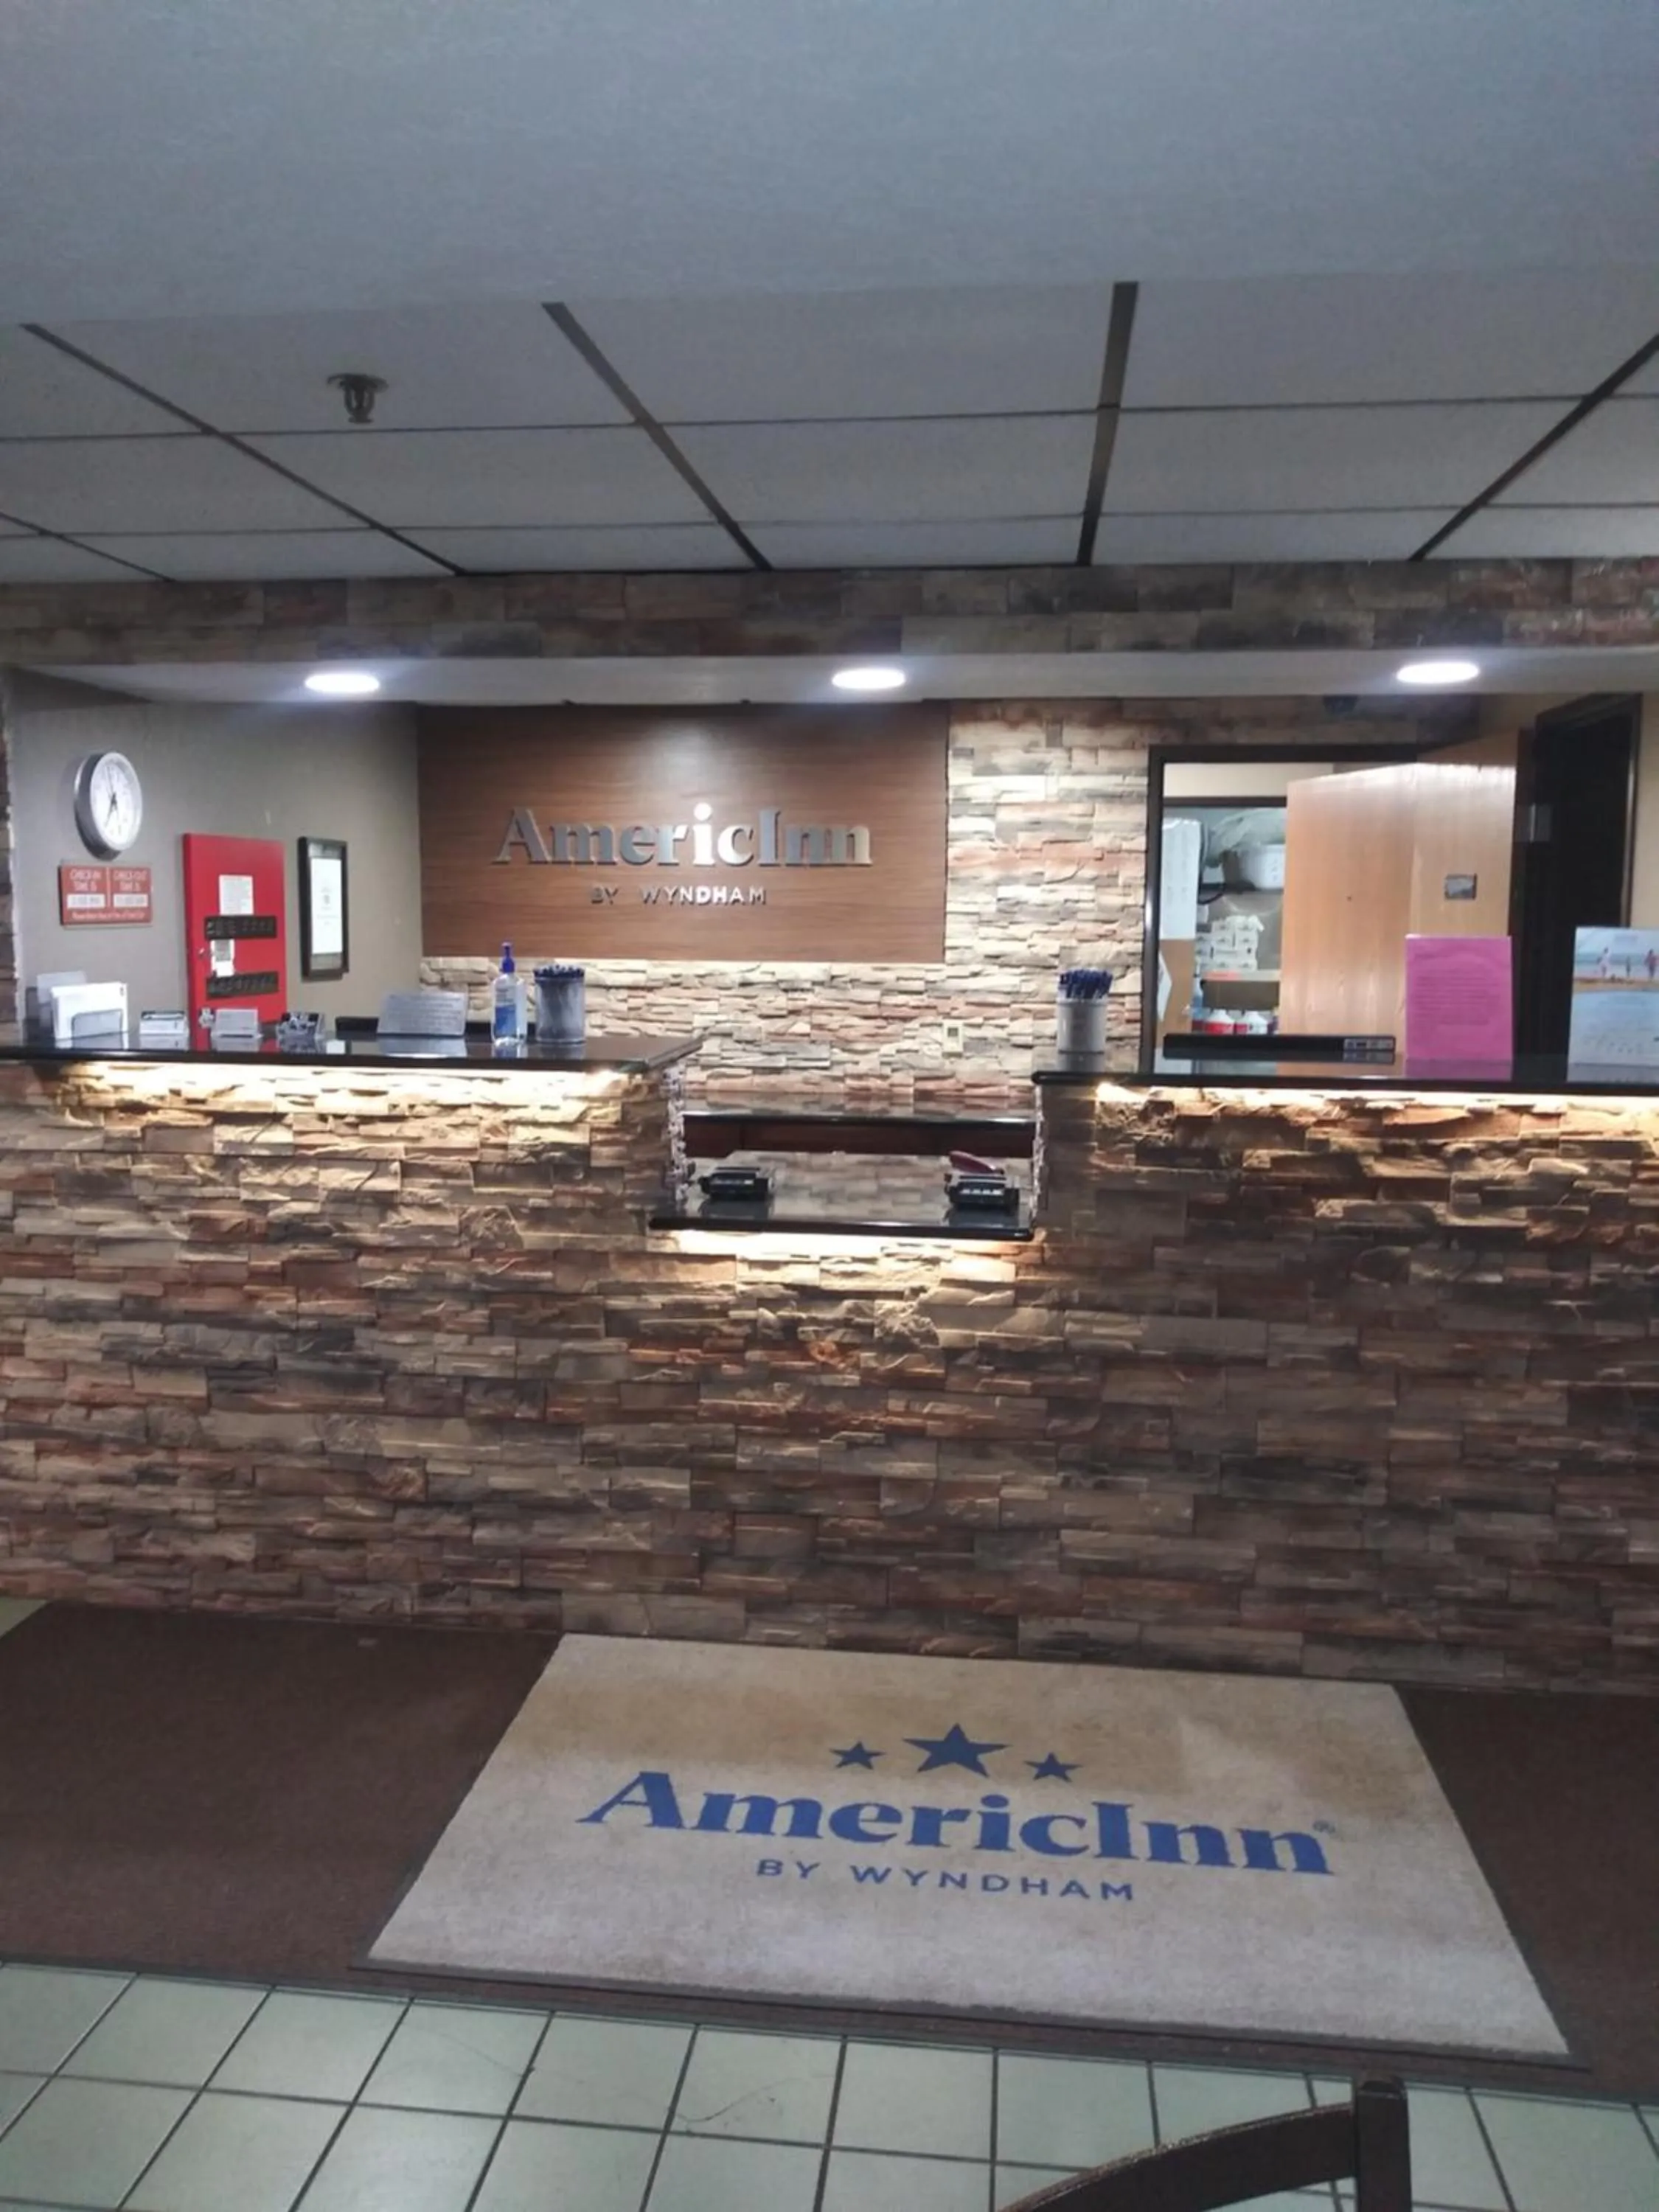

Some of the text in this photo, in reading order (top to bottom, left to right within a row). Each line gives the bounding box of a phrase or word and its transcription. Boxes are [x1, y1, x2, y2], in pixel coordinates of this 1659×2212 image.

[493, 802, 874, 866] AmericInn
[591, 885, 768, 906] BY WYNDHAM
[575, 1771, 1334, 1876] AmericInn
[757, 1858, 1133, 1901] BY WYNDHAM
